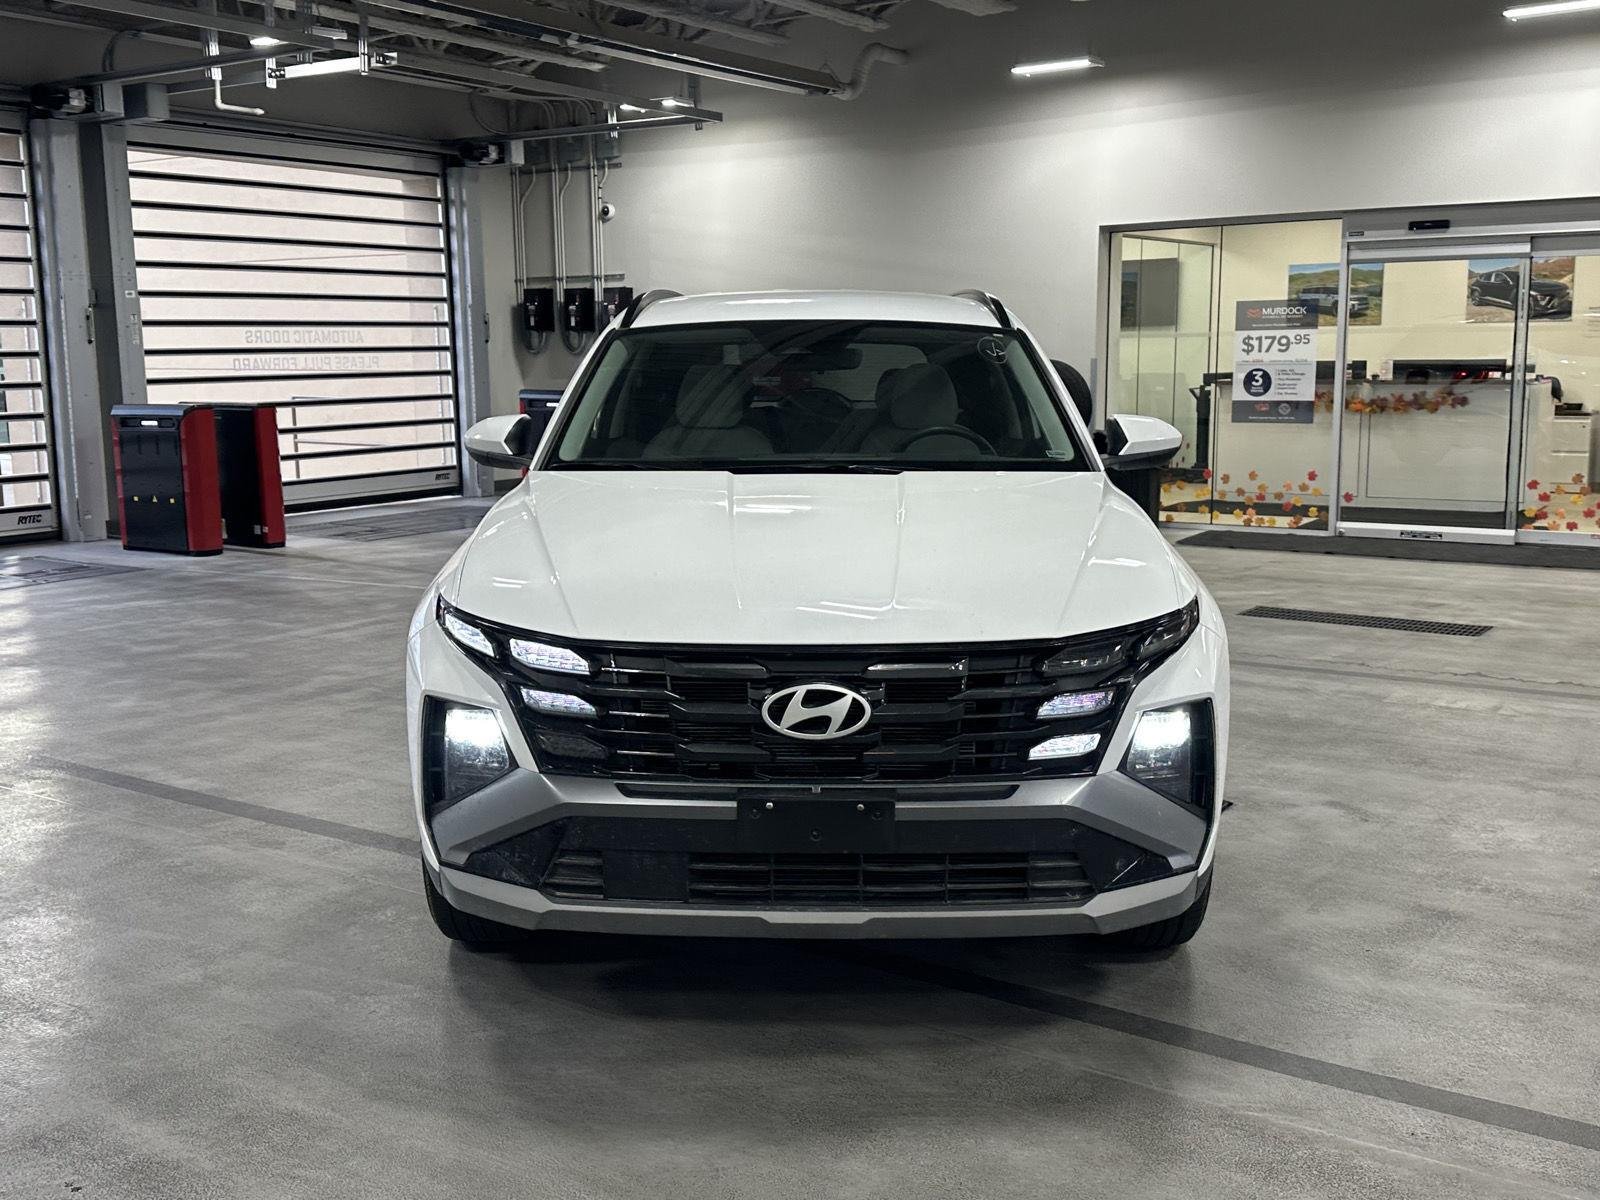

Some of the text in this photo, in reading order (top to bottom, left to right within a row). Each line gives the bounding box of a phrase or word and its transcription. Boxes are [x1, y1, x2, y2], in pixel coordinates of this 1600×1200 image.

[1262, 306, 1307, 315] MURDOCK
[1241, 333, 1311, 356] $179.95
[1251, 370, 1264, 387] 3
[17, 514, 42, 525] RYTEC
